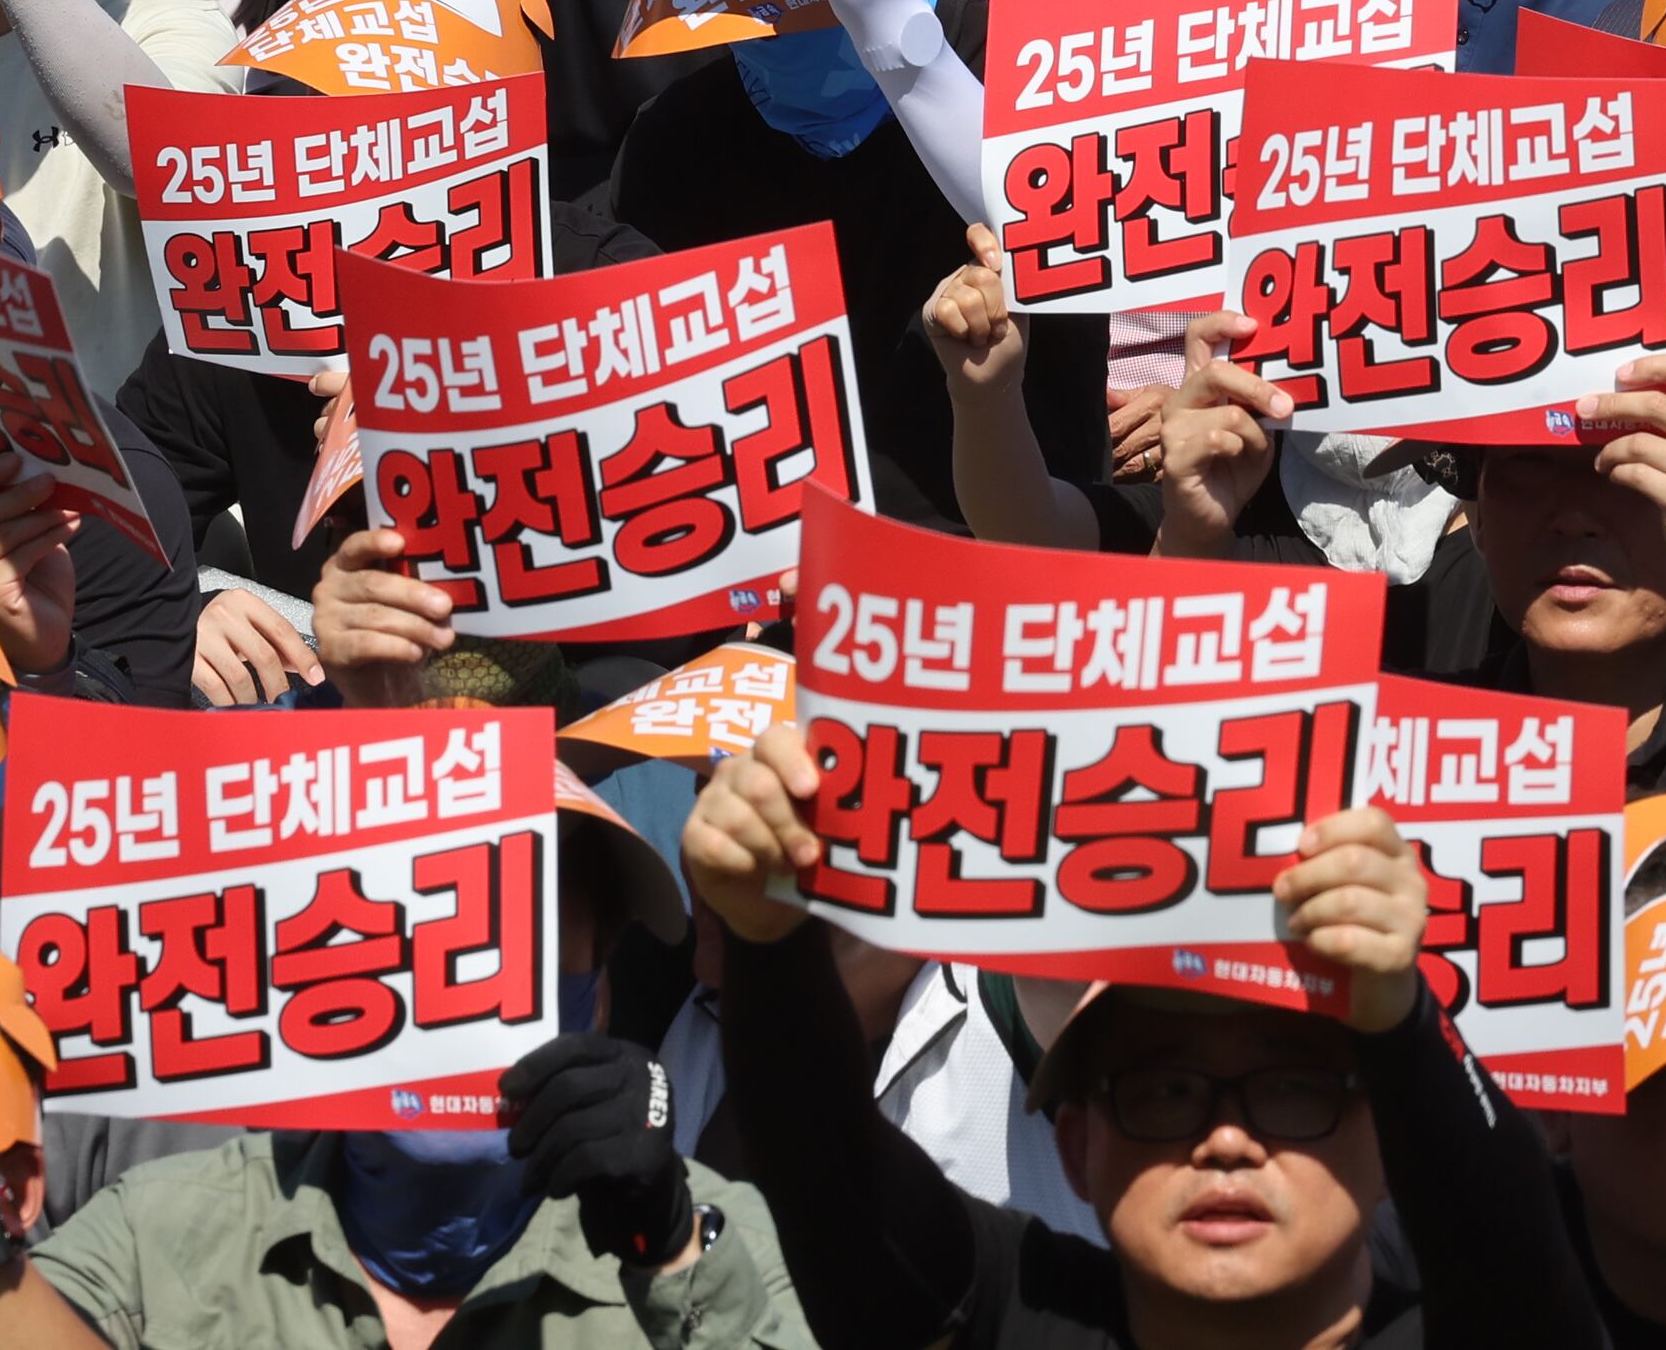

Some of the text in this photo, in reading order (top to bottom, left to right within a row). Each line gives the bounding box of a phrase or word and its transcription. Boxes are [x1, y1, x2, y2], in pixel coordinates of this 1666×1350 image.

[248, 0, 439, 62] 단체교섭
[1015, 24, 1154, 111] 25년
[158, 90, 510, 206] 25년 단체교섭
[1258, 93, 1635, 211] 25년 단체교섭
[369, 248, 795, 413] 25년 단체교섭
[377, 334, 850, 610] 완전승리
[815, 584, 1328, 692] 25년 단체교섭
[31, 721, 501, 868] 25년 단체교섭
[797, 700, 1360, 917] 완전승리
[17, 831, 541, 1092] 완전승리
[1214, 959, 1333, 994] 현대자동차지부
